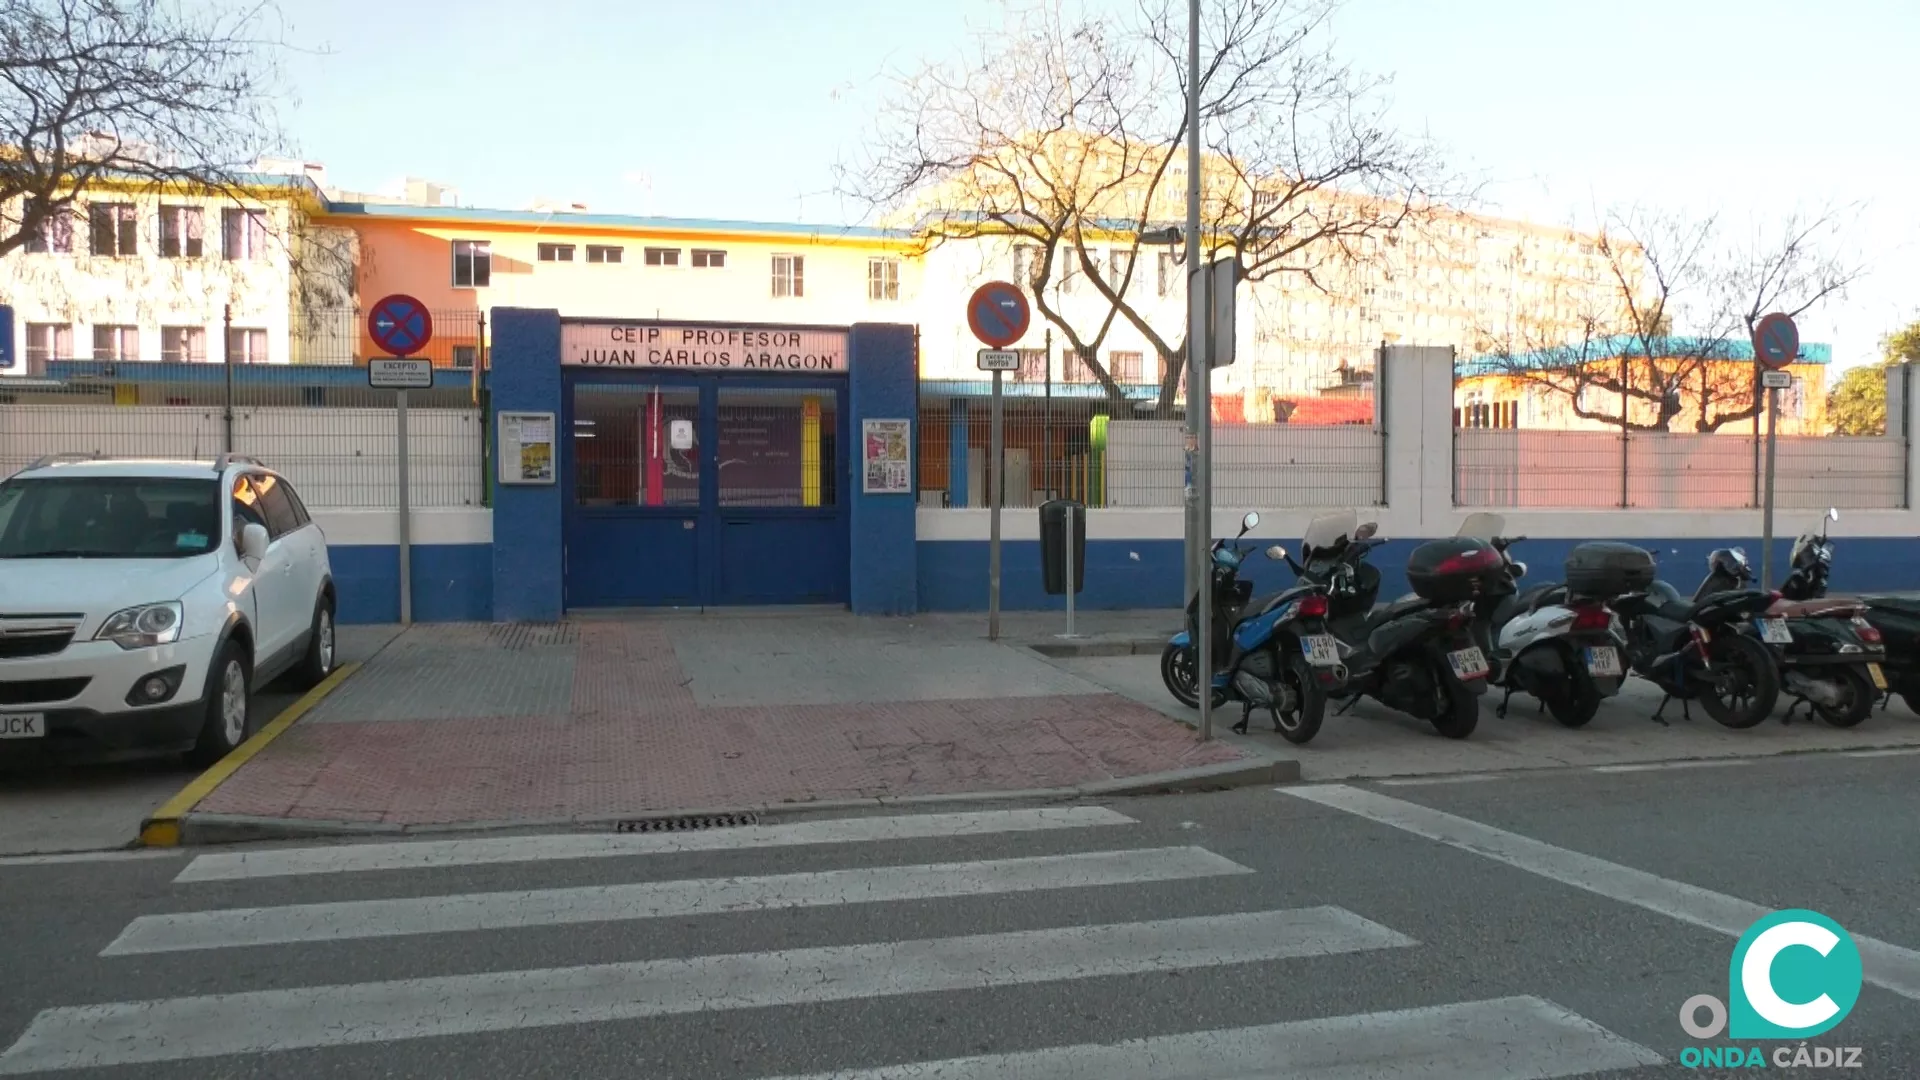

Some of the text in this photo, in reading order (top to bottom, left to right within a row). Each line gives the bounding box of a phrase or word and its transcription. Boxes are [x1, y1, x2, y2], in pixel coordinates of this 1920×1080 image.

[611, 327, 801, 348] CEIP PROFESOR
[384, 361, 418, 370] EXCEPTO
[580, 349, 636, 365] JUAN
[649, 350, 731, 366] CARLOS
